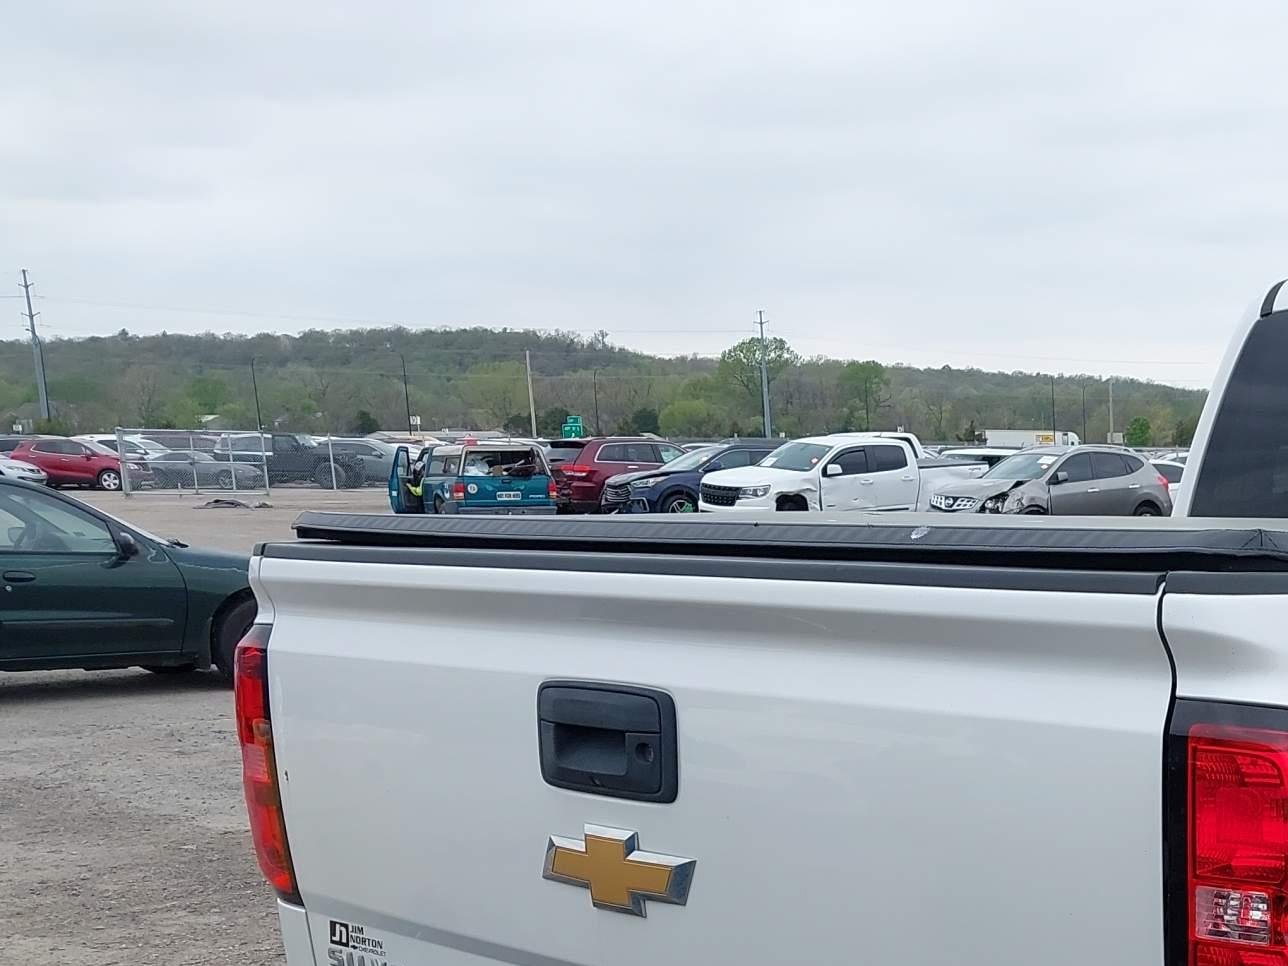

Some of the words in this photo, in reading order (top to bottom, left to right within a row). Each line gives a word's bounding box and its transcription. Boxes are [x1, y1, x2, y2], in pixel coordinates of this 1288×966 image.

[350, 925, 365, 935] JIM
[350, 934, 383, 949] NORTON
[358, 946, 386, 957] CHEVROLET
